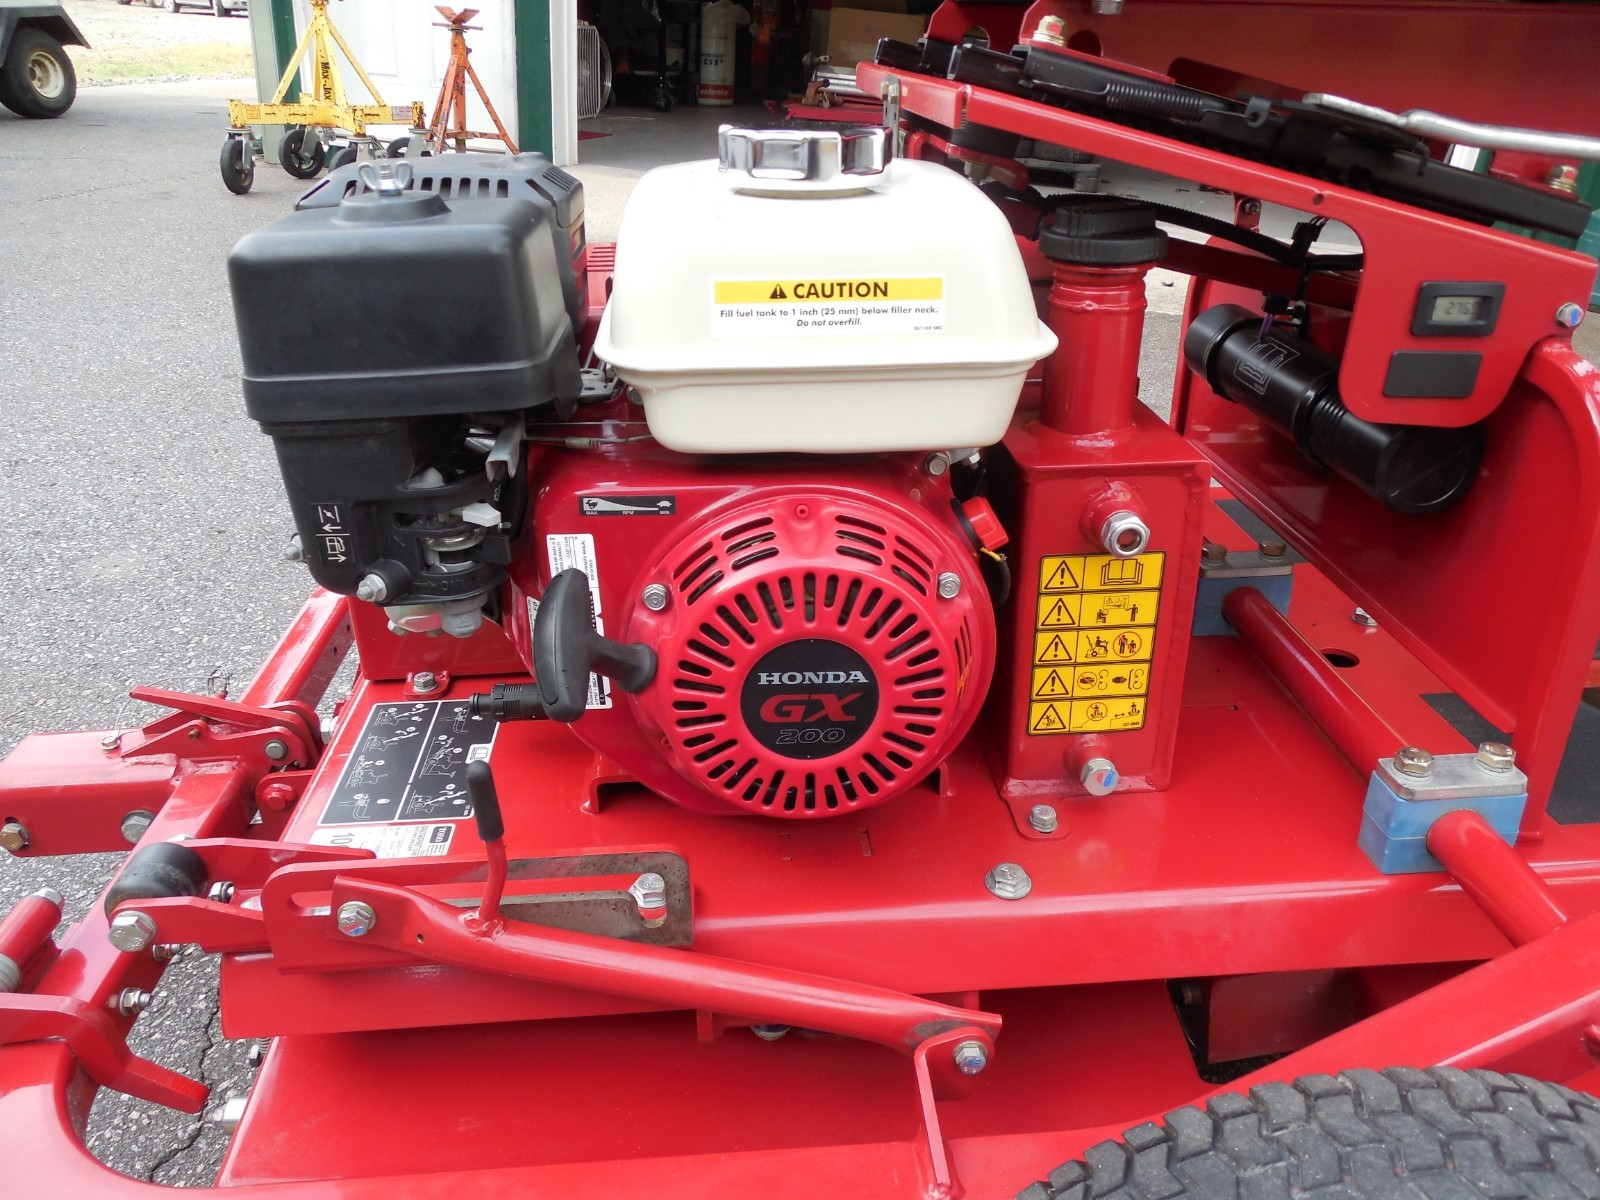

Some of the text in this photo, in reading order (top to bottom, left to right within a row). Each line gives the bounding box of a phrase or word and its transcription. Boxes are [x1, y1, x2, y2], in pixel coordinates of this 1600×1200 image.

[793, 282, 888, 299] CAUTION
[736, 309, 753, 317] fuel
[756, 309, 777, 317] tank
[792, 308, 796, 316] 1
[799, 308, 818, 316] inch
[821, 307, 836, 317] (25
[838, 307, 859, 316] mm)
[861, 306, 889, 314] below
[891, 306, 912, 314] filler
[914, 306, 939, 314] neck.
[796, 319, 809, 327] Do
[828, 318, 862, 326] overfill.
[758, 670, 869, 685] HONDA
[760, 693, 864, 722] GX
[776, 728, 845, 744] 200
